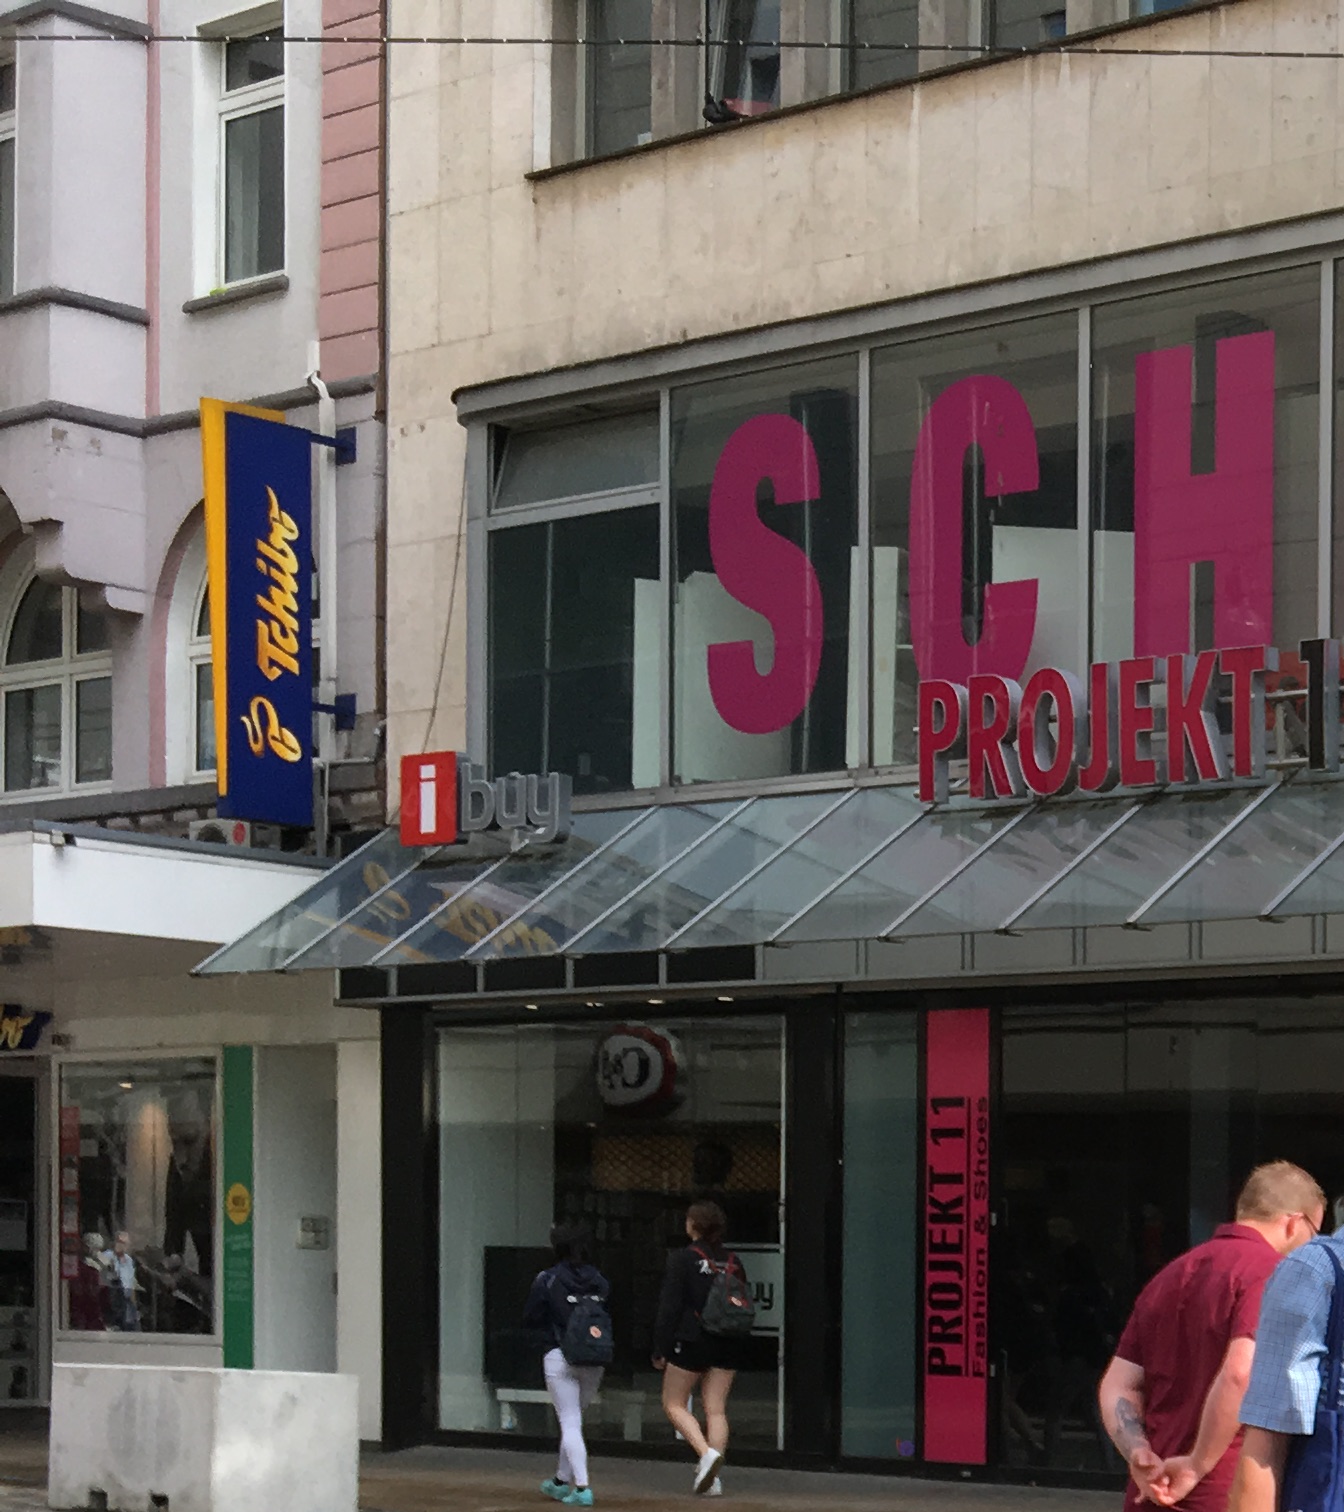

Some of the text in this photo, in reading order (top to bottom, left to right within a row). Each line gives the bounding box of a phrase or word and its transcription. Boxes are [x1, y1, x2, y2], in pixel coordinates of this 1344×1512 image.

[256, 484, 299, 682] Tchibo
[918, 644, 1274, 803] PROJEKT
[927, 1096, 966, 1378] PROJEKT 11
[971, 1096, 989, 1379] Fashion & Shoes
